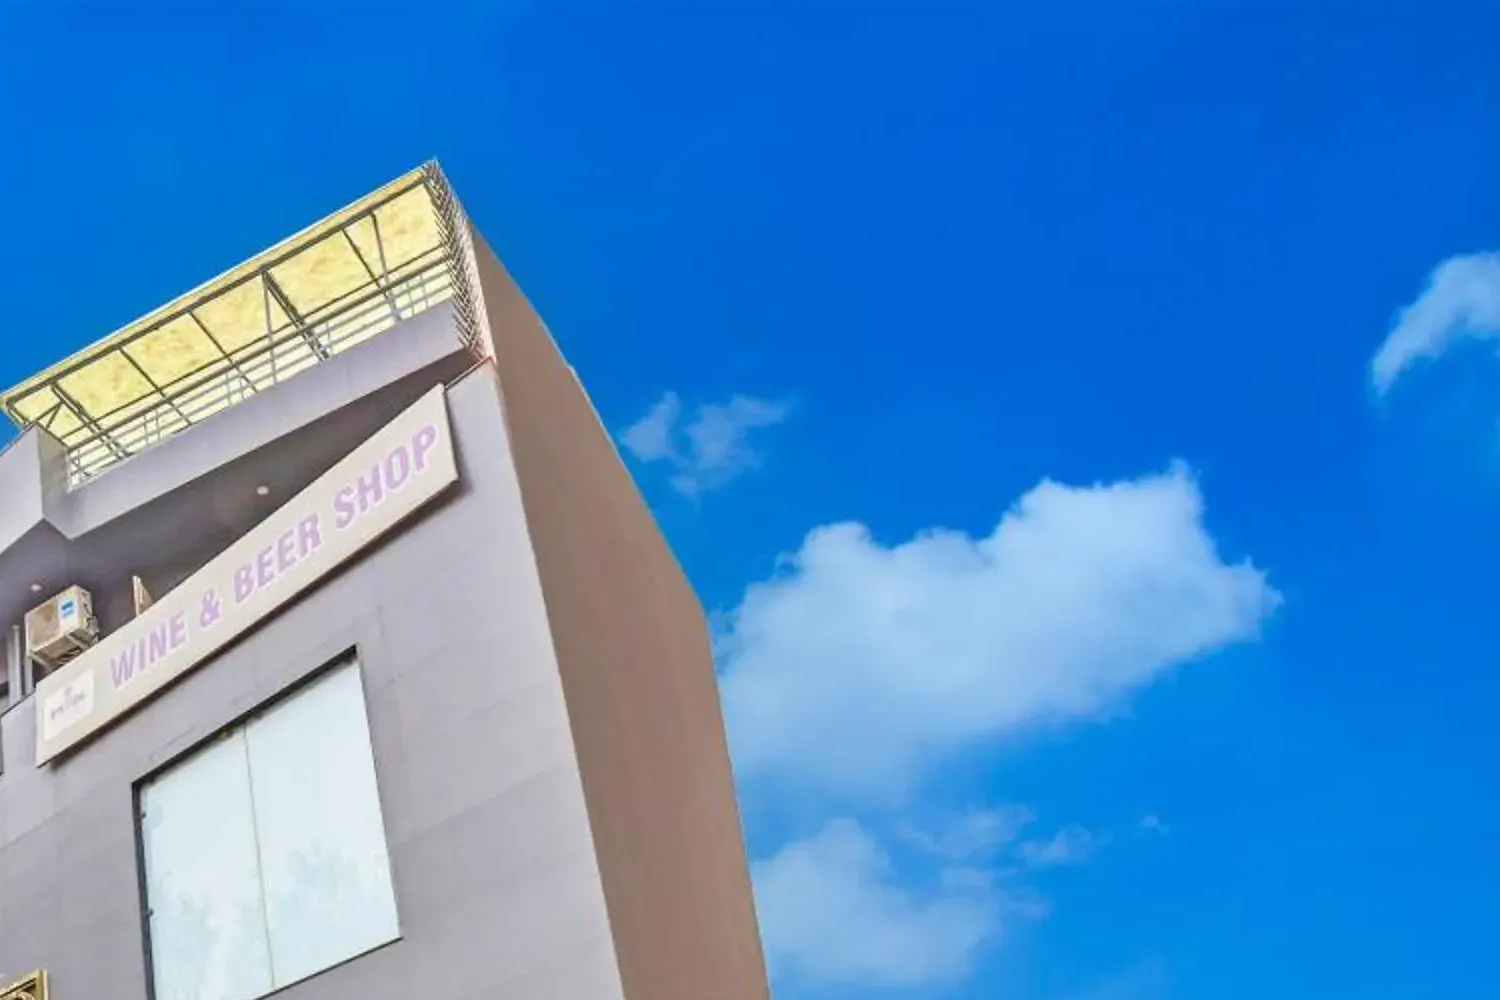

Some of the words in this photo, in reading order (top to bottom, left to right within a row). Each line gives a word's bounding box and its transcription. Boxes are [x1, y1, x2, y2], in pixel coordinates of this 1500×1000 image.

[109, 610, 188, 688] WINE
[199, 588, 221, 629] &
[232, 514, 322, 603] BEER
[334, 424, 438, 529] SHOP
